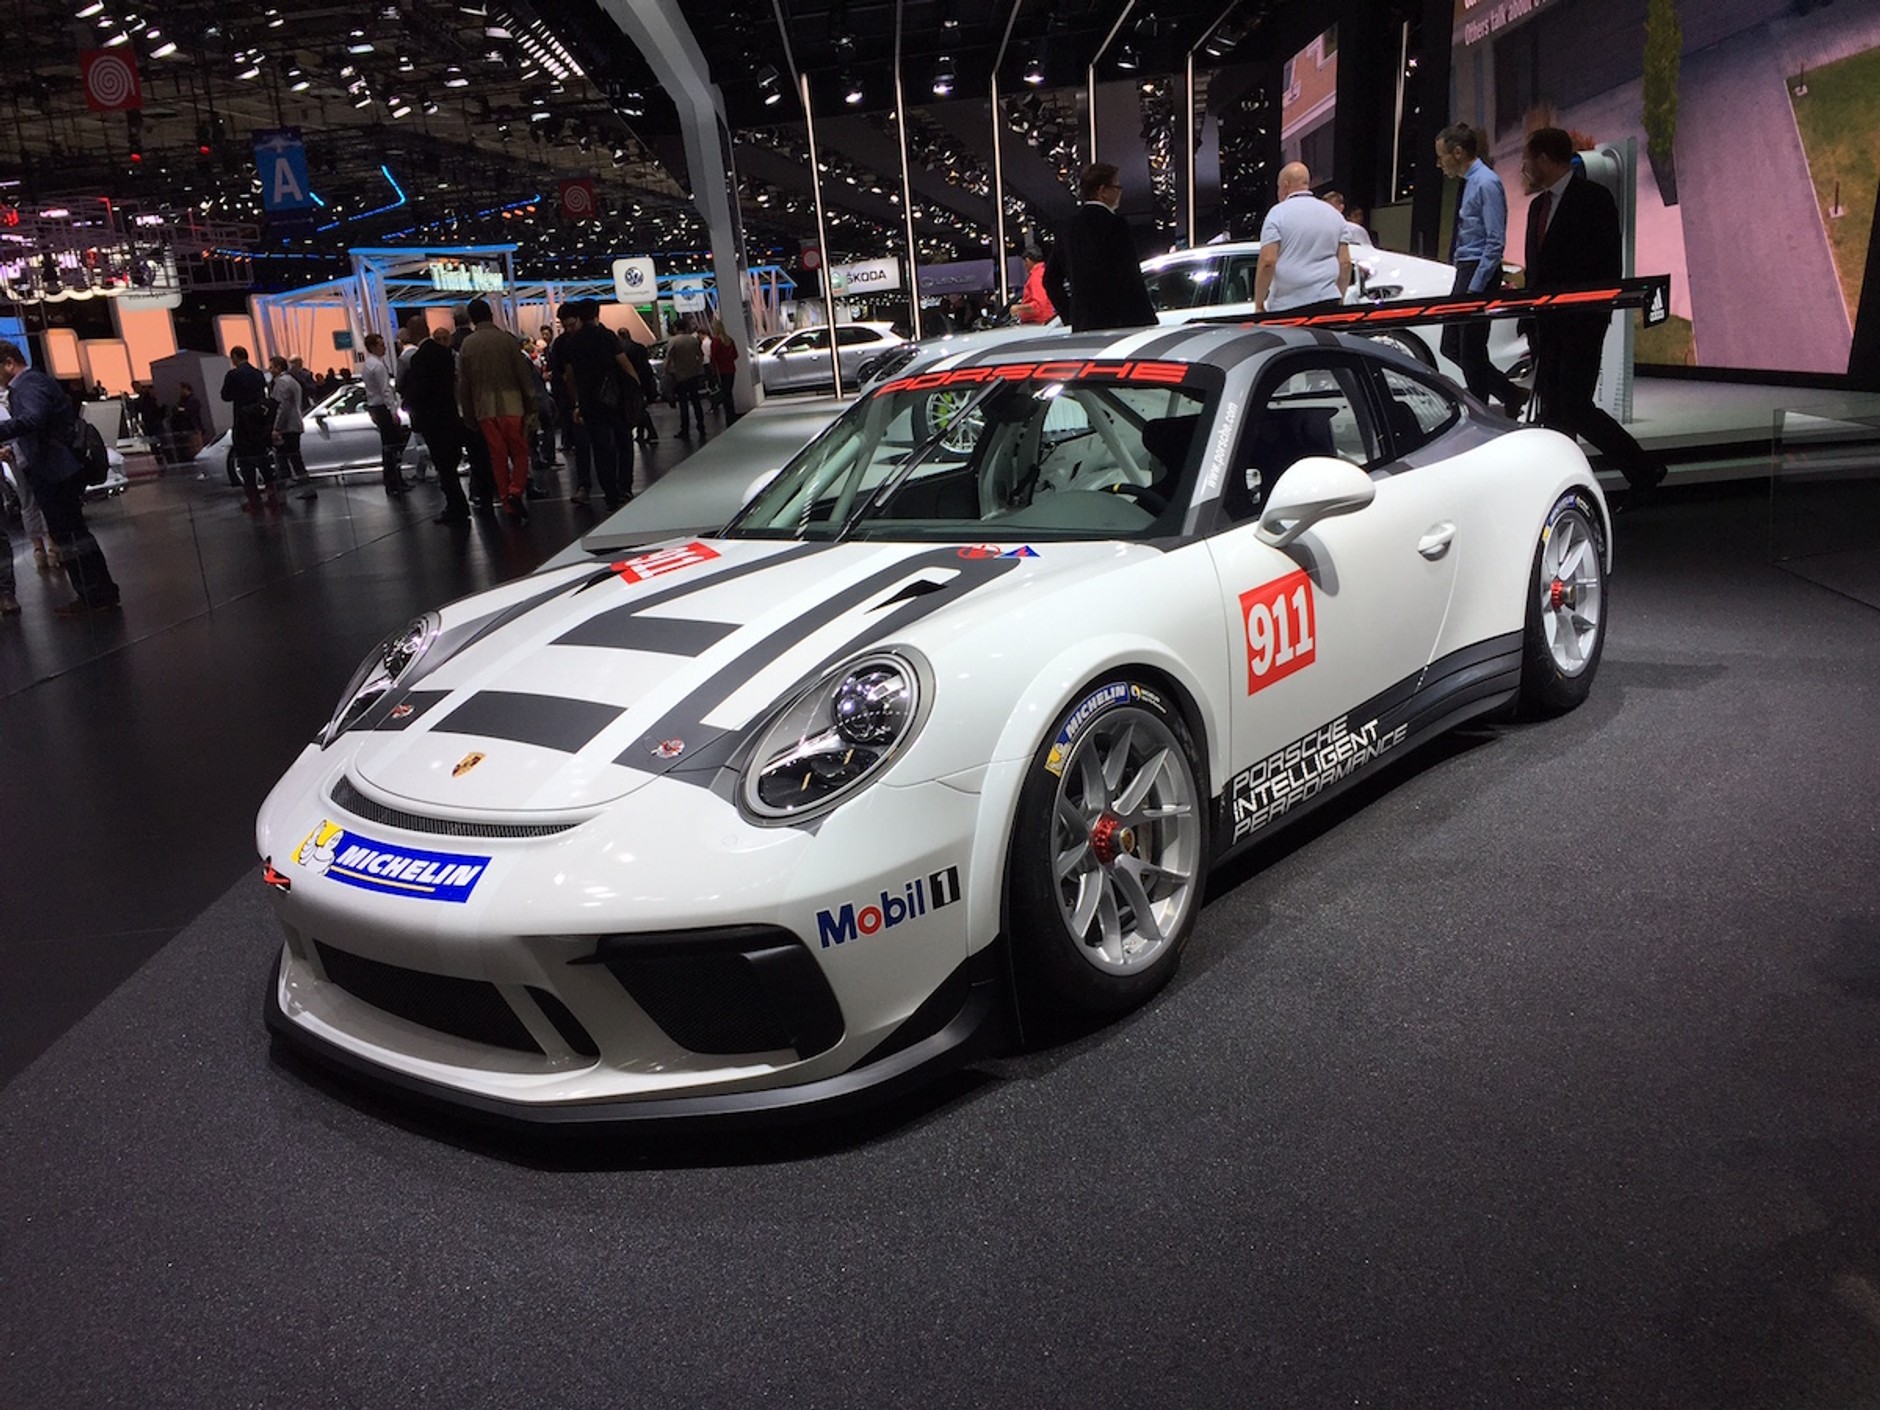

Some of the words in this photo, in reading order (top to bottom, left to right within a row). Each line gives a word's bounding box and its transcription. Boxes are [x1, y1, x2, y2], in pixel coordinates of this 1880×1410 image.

[1464, 19, 1489, 46] Others
[273, 158, 304, 203] A
[1239, 288, 1622, 330] ORSCHE
[873, 362, 1188, 399] PORSCHE
[1207, 402, 1239, 489] www.porsche.com
[1248, 584, 1314, 676] 911
[1065, 684, 1126, 739] MICHELIN
[1232, 715, 1349, 800] PORSCHE
[1232, 719, 1378, 823] INTELLIGENT
[1232, 723, 1409, 846] PERFORMANCE
[336, 845, 483, 887] MICHELIN
[816, 879, 926, 949] Mobil
[934, 868, 955, 907] 1
